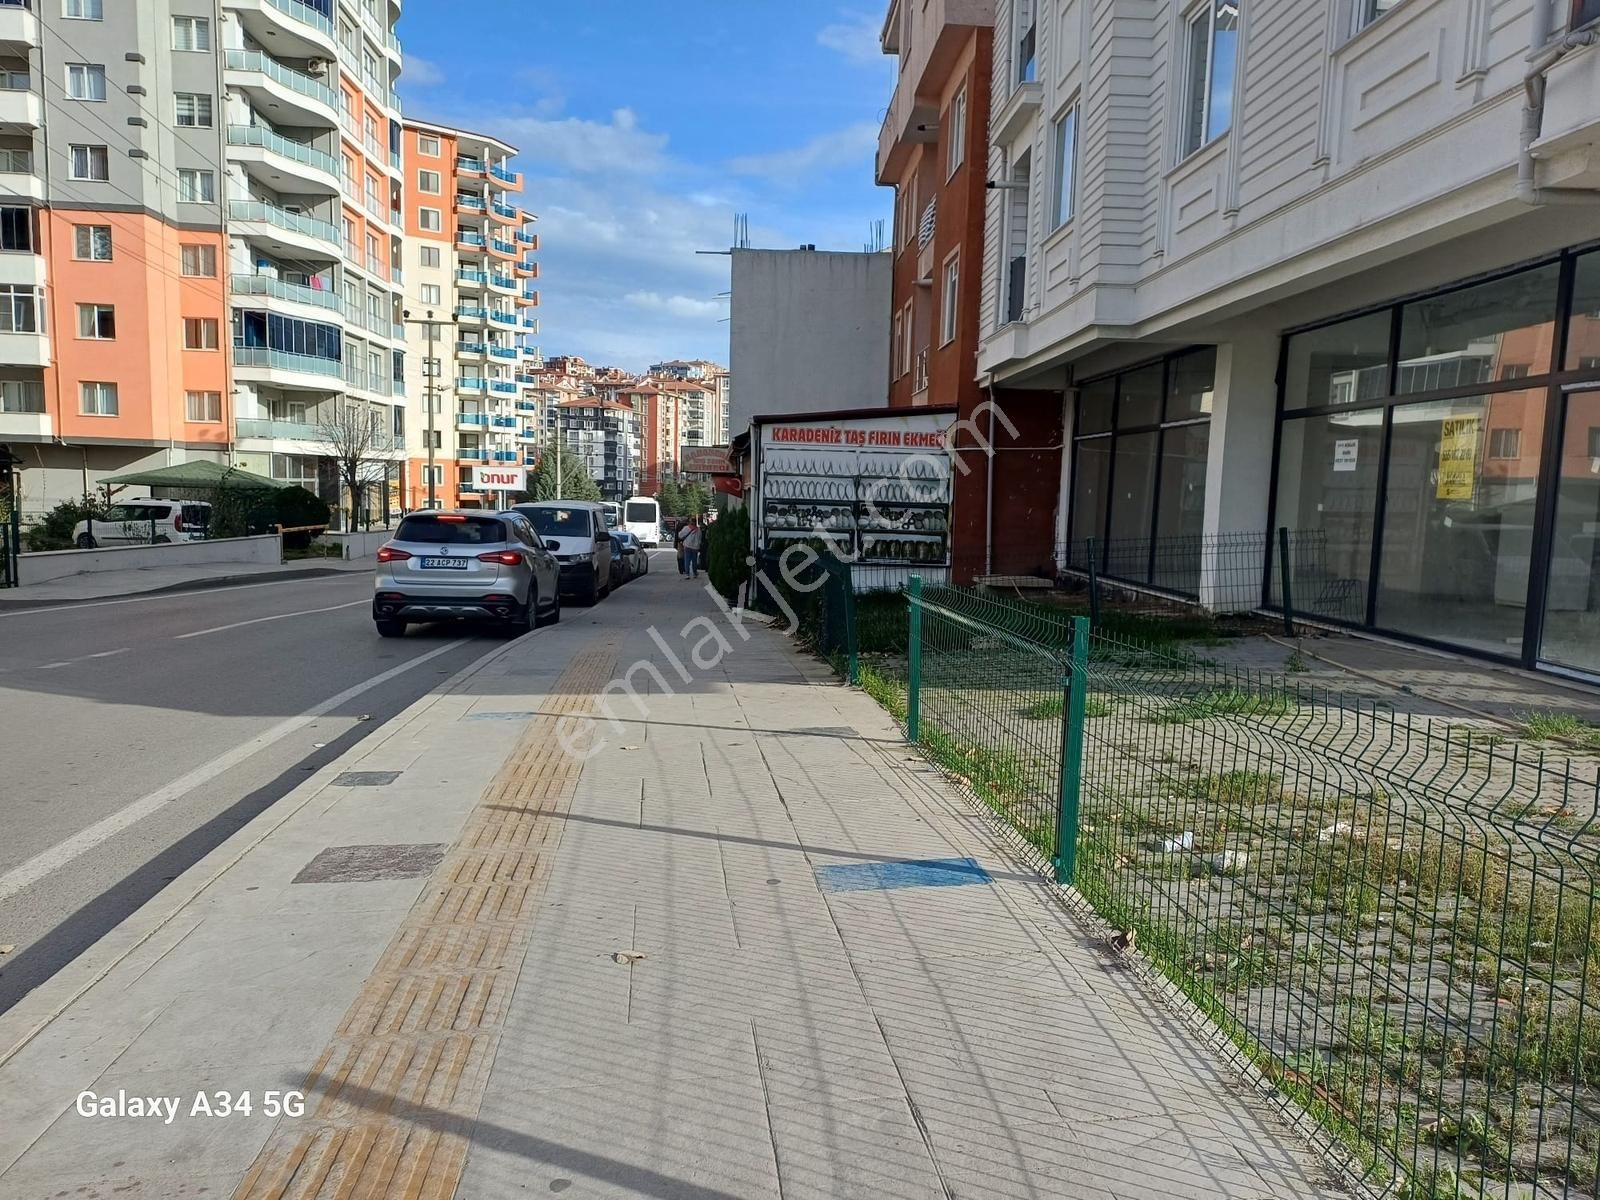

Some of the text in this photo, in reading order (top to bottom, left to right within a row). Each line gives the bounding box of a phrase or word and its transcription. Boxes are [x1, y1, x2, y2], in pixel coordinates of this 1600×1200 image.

[772, 426, 842, 443] KARADENİZ
[868, 430, 901, 446] FIRIN
[480, 471, 518, 484] onur
[451, 559, 466, 567] 737
